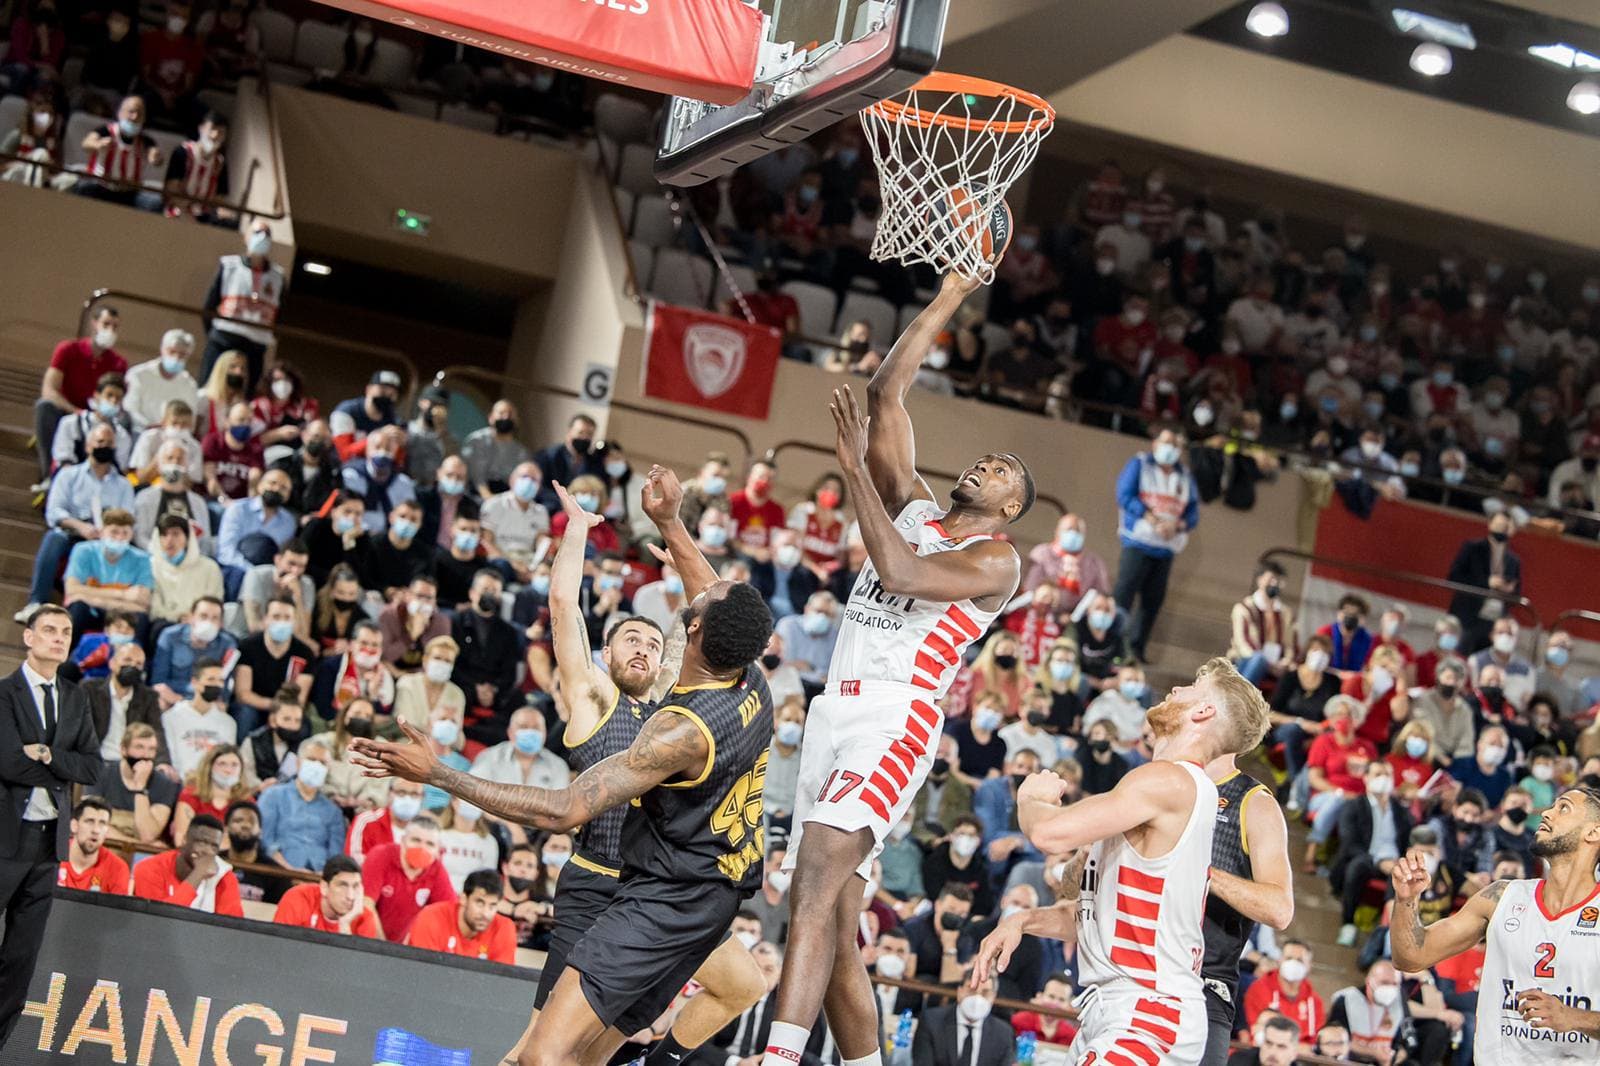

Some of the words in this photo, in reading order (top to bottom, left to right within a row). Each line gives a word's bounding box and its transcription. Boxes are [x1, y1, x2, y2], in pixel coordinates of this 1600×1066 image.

[439, 30, 529, 57] TURKISH
[536, 56, 629, 81] AIRLINES
[584, 370, 608, 400] G
[816, 769, 865, 803] 17
[1534, 942, 1557, 978] 2
